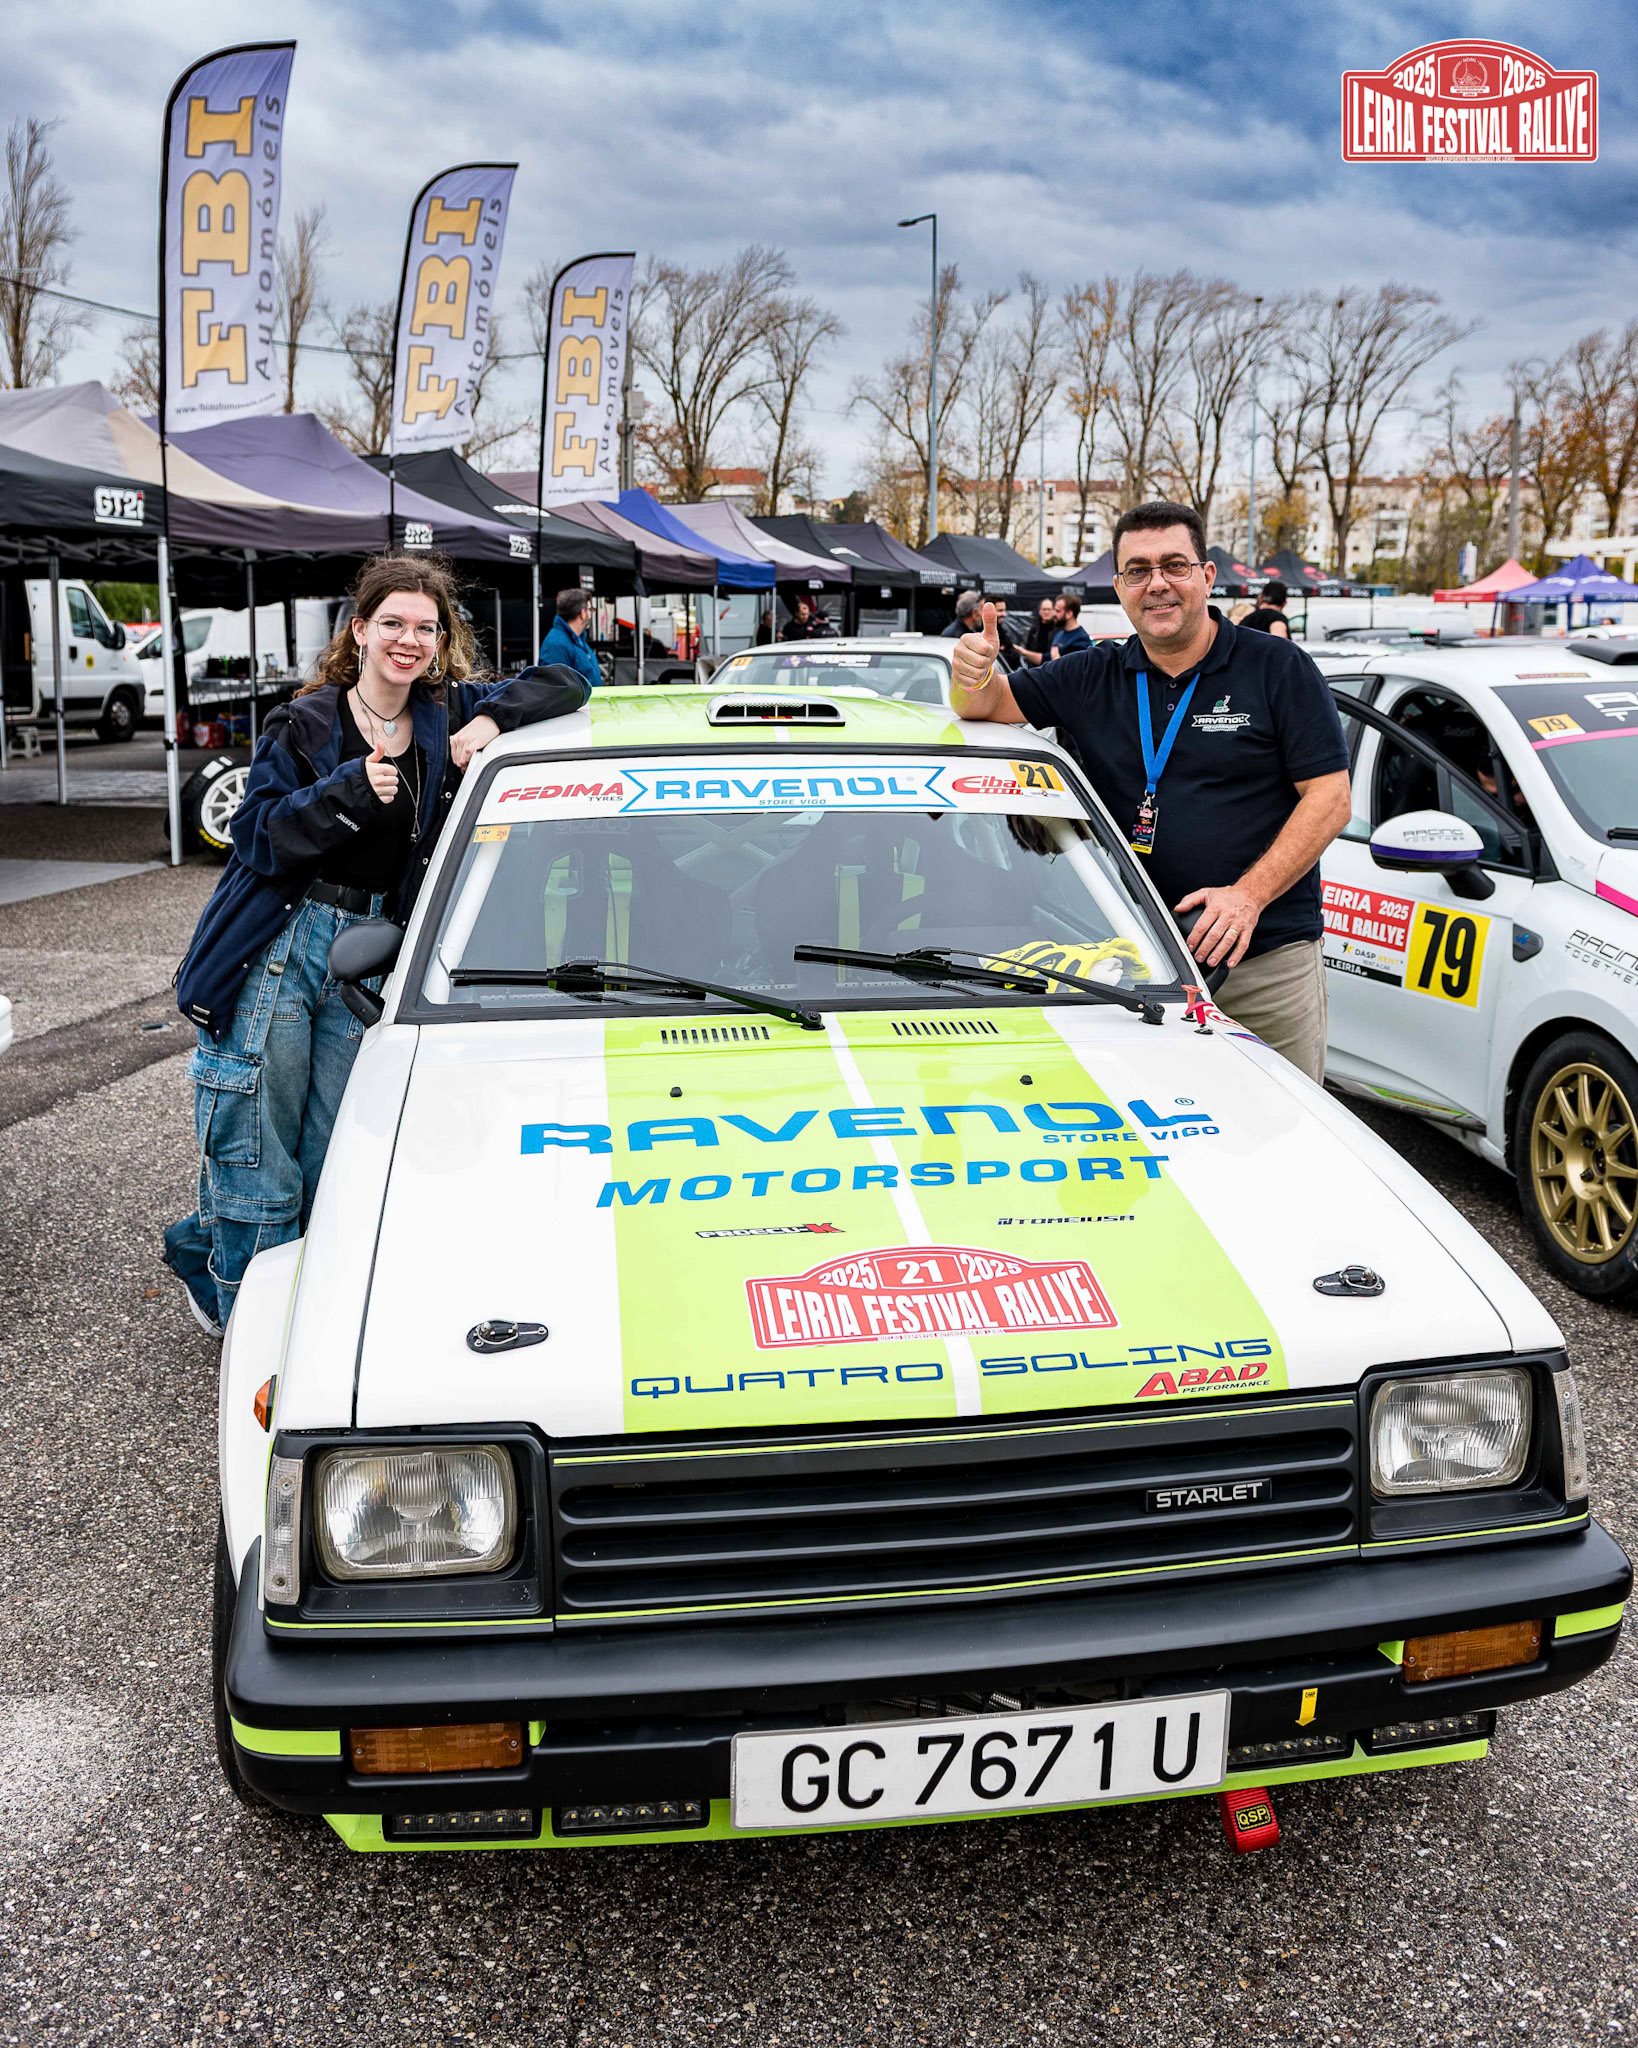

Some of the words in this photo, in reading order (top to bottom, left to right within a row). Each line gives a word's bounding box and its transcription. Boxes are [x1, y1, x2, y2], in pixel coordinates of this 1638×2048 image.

[181, 95, 257, 390] FBI
[254, 94, 282, 382] Automóveis
[402, 196, 485, 426] FBI
[454, 198, 503, 417] Automóveis
[552, 286, 609, 479] FBI
[599, 288, 626, 474] Automóveis
[94, 486, 145, 520] GT2i
[1537, 718, 1568, 732] 79
[498, 782, 624, 803] FEDIMA
[1018, 763, 1055, 789] 21
[1403, 829, 1464, 837] RACING
[1323, 885, 1372, 914] EIRIA
[1378, 900, 1410, 921] 2025
[1352, 916, 1406, 947] RALLYE
[1355, 948, 1377, 959] DASP
[1417, 909, 1477, 998] 79
[1042, 1132, 1138, 1144] STORE
[1151, 1125, 1221, 1141] VIGO
[596, 1155, 1170, 1208] MOTORSPORT
[818, 1257, 878, 1291] 2025
[896, 1259, 944, 1285] 21
[959, 1253, 1023, 1285] 2025
[760, 1284, 862, 1342] LEIRIA
[861, 1289, 1000, 1335] FESTIVAL
[993, 1267, 1105, 1329] RALLYE
[631, 1363, 943, 1399] QUATRO
[980, 1338, 1272, 1376] SOLING
[1134, 1362, 1269, 1398] ABAD
[1182, 1379, 1271, 1394] PERFORMANCE
[1156, 1482, 1264, 1509] STARLET
[780, 1740, 887, 1813] GC
[915, 1721, 1116, 1806] 7671
[1152, 1712, 1201, 1784] U
